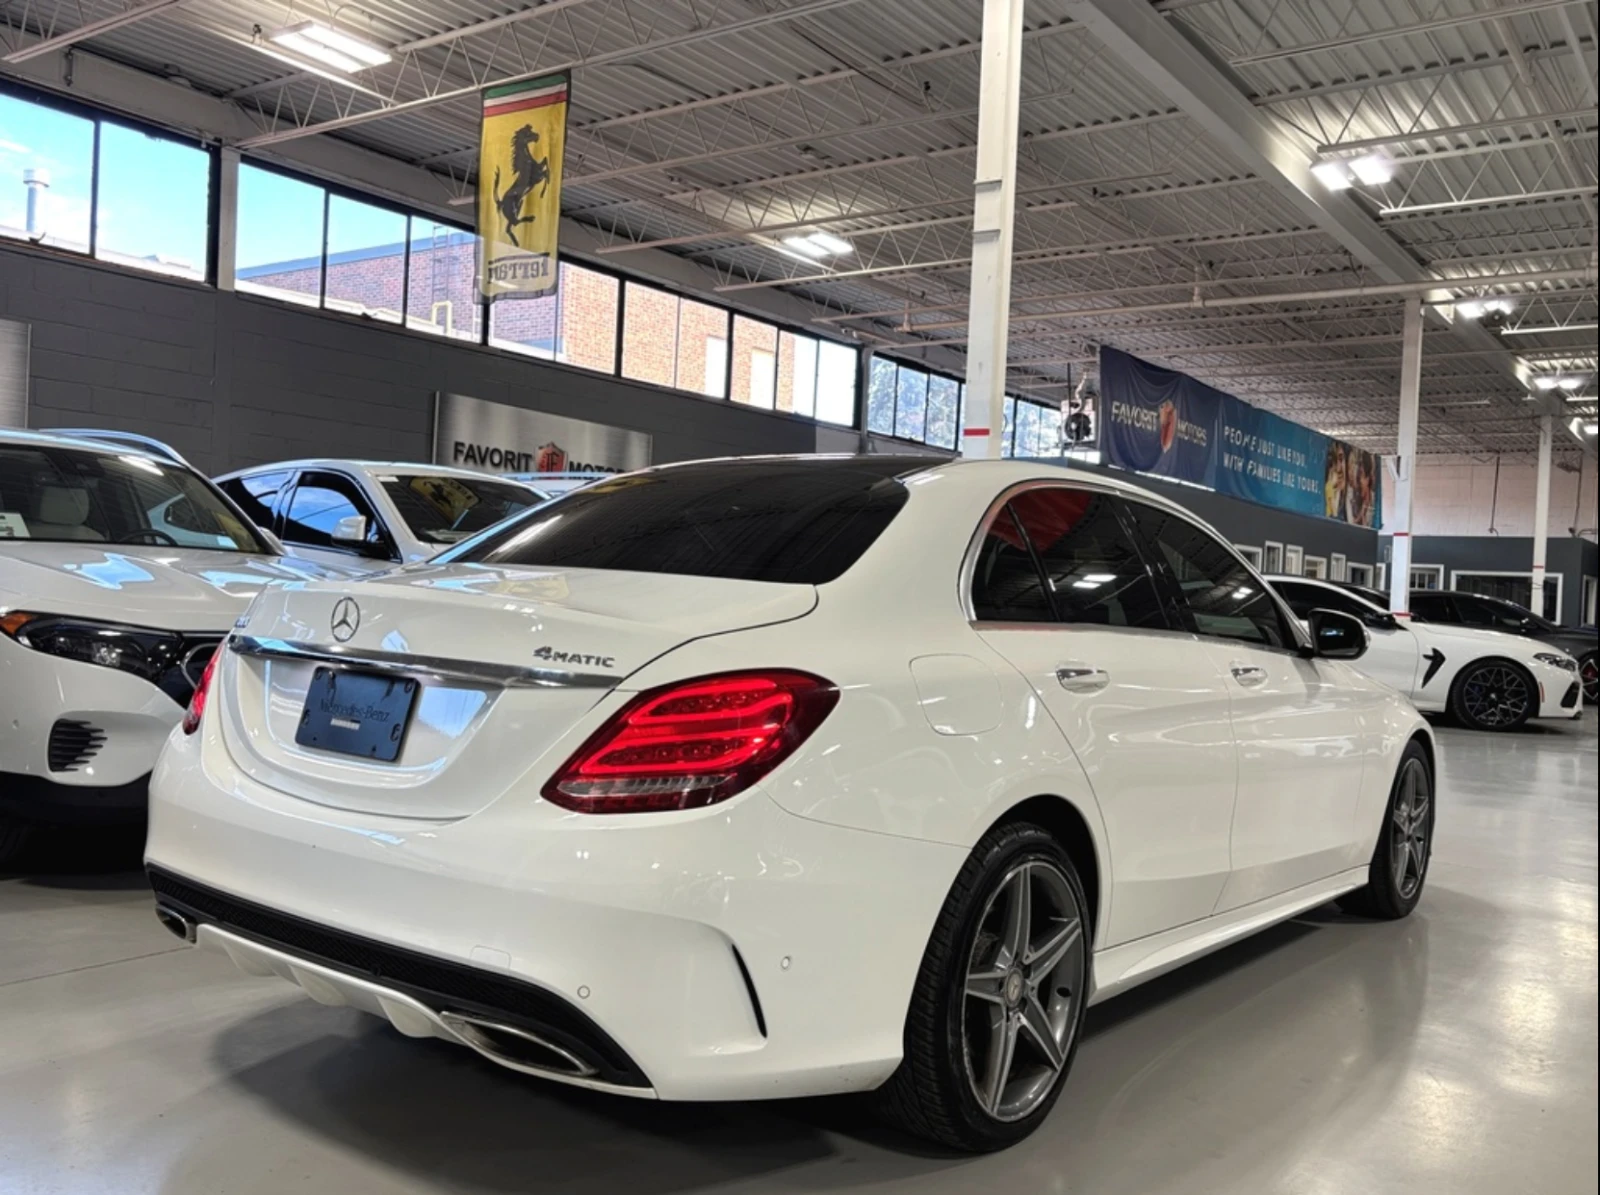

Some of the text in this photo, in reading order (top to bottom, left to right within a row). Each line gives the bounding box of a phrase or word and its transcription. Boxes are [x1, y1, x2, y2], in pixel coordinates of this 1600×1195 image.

[1111, 400, 1207, 447] FAVORIT MOTORS
[453, 441, 625, 475] FAVORIT MOT
[1257, 439, 1275, 456] JUST
[533, 645, 614, 668] 4MATIC
[320, 699, 390, 722] Mercedes-Benz
